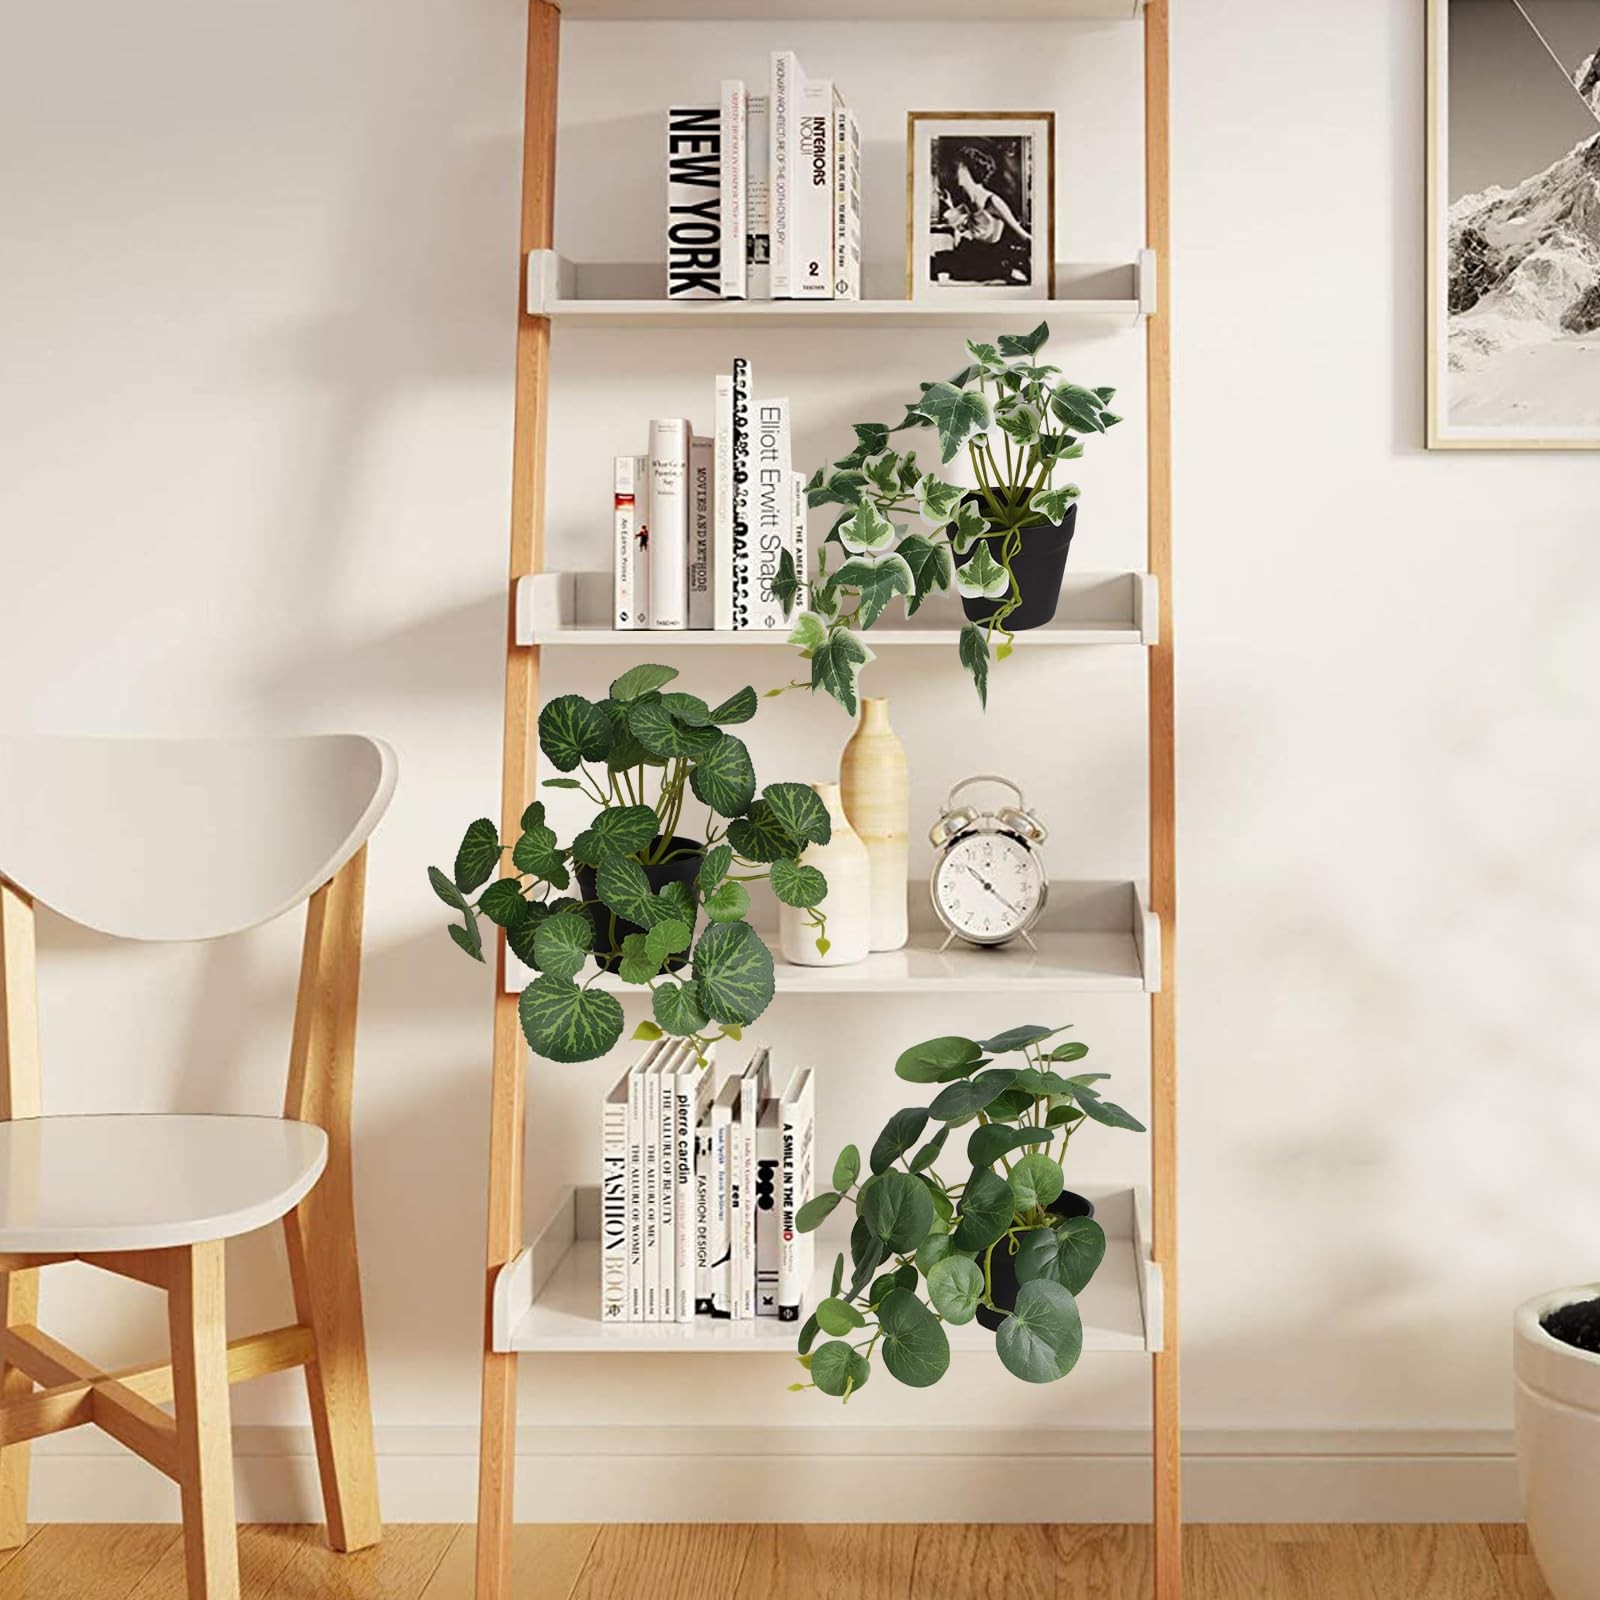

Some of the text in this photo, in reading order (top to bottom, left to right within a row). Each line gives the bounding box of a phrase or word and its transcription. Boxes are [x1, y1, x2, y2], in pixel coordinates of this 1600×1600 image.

[813, 117, 826, 187] INTERIORS
[669, 110, 721, 295] NEW YORK
[809, 262, 820, 277] 2
[757, 407, 781, 603] Elliott Erwitt Snaps
[697, 467, 707, 592] MOVIES AND METHODS
[796, 525, 804, 545] THE
[604, 1106, 625, 1152] THE
[676, 1095, 690, 1137] pierre
[783, 1123, 794, 1132] A
[663, 1088, 672, 1225] THE ALLURE OF BEAUTY
[679, 1140, 691, 1185] cardin
[783, 1134, 794, 1169] SMILE
[647, 1144, 656, 1248] THE ALLURE OF MEN
[731, 1185, 740, 1208] zen
[783, 1171, 794, 1184] IN
[783, 1187, 794, 1208] THE
[604, 1157, 625, 1251] FASHION
[631, 1144, 640, 1266] THE ALLURE OF WOMEN
[697, 1175, 707, 1268] FASHION DESIGN
[783, 1210, 794, 1242] MIND
